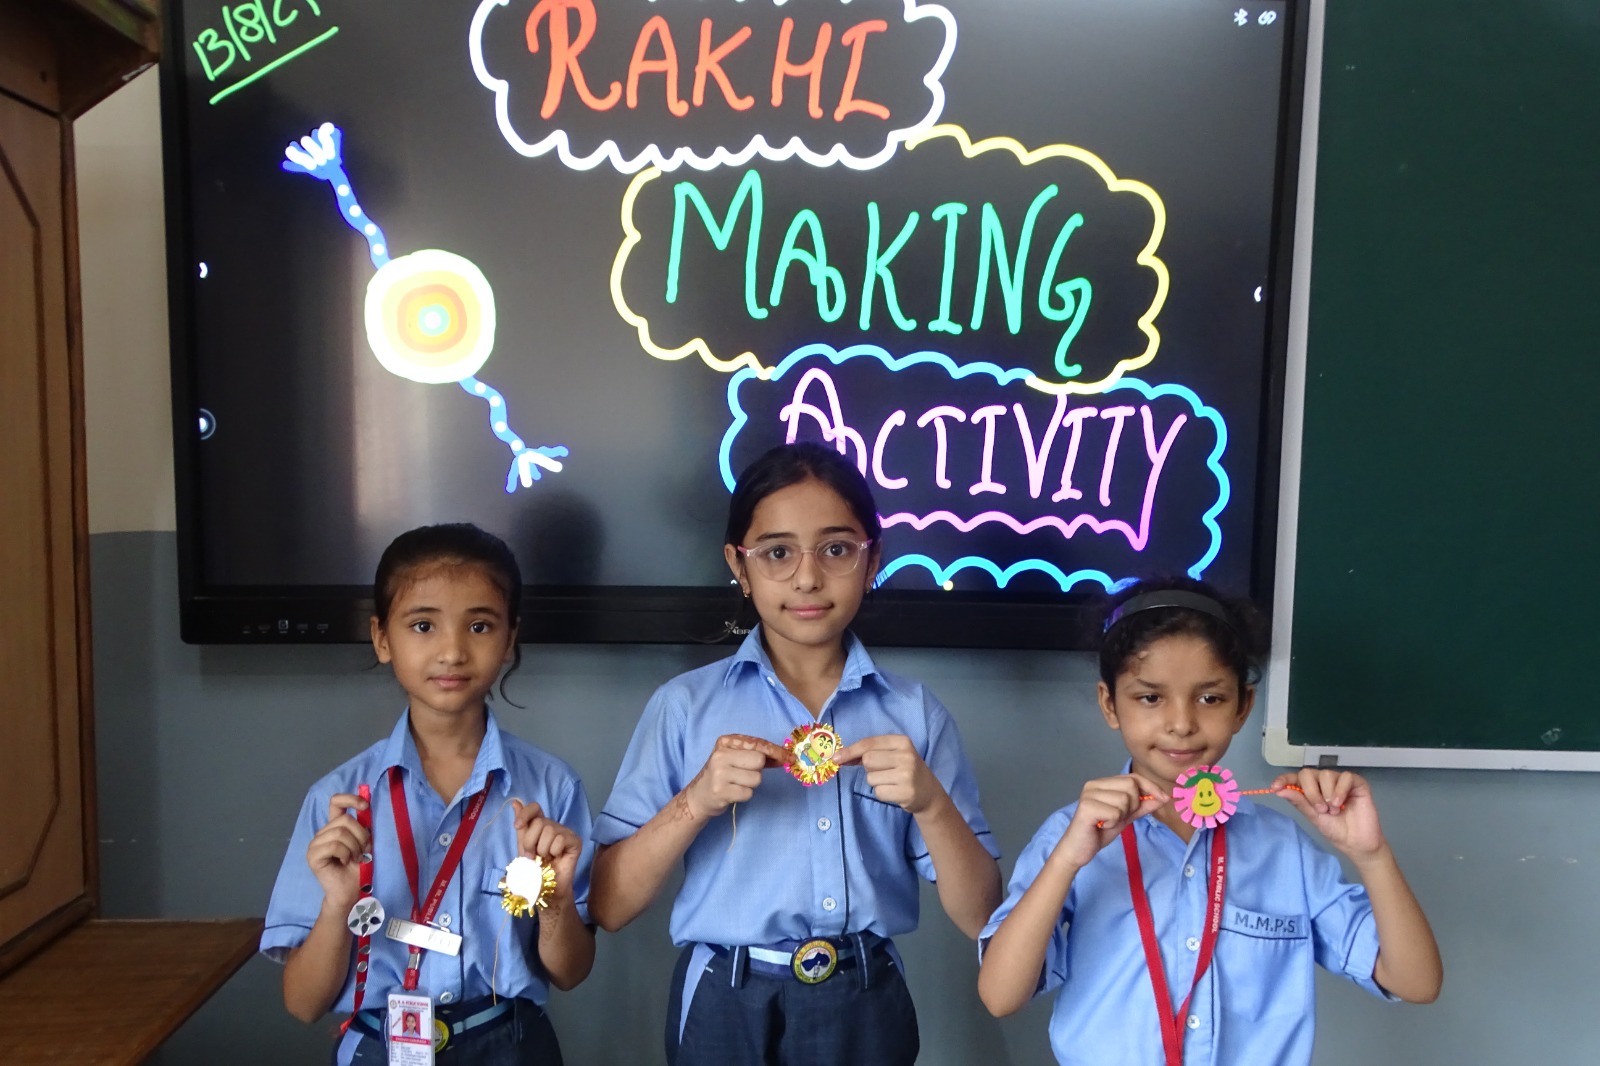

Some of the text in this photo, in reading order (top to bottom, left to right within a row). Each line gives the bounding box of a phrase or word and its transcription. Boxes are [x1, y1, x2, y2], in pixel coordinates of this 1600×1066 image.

[525, 0, 891, 121] RAKHI
[666, 169, 1092, 377] MAKING
[779, 367, 1188, 551] ACTIVITY
[1212, 902, 1220, 934] SCHOOL
[1214, 875, 1223, 902] PUBLIC
[1234, 911, 1296, 933] M.M.P.S
